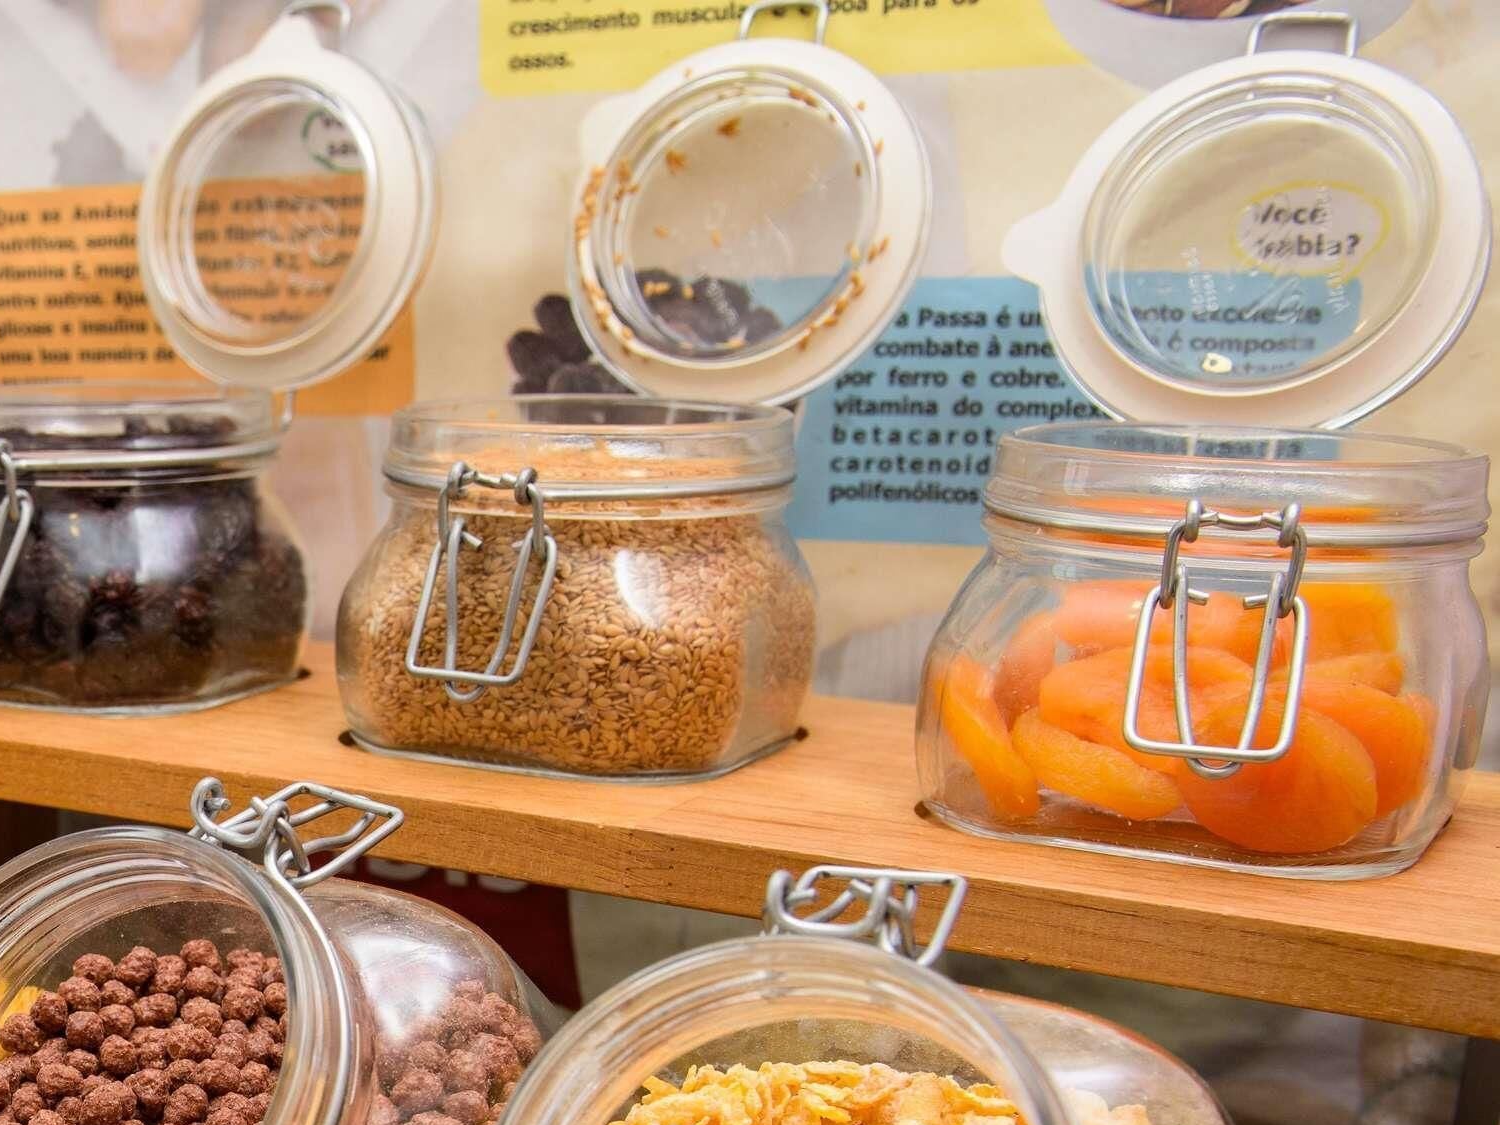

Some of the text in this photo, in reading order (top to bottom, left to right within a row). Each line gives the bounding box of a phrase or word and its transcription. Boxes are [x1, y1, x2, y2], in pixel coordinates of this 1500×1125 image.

[509, 11, 641, 36] crescimento
[652, 2, 745, 25] muscula
[508, 54, 575, 71] ossos.
[917, 307, 988, 328] Passa
[996, 306, 1012, 327] é
[873, 338, 981, 359] combate
[987, 335, 1002, 358] à
[1008, 343, 1054, 358] ane
[834, 367, 1066, 389] por ferro e cobre.
[833, 395, 938, 417] vitamina
[952, 396, 984, 417] do
[830, 425, 995, 446] betacarot
[829, 454, 992, 475] carotenoid
[828, 480, 982, 503] polifenólicos
